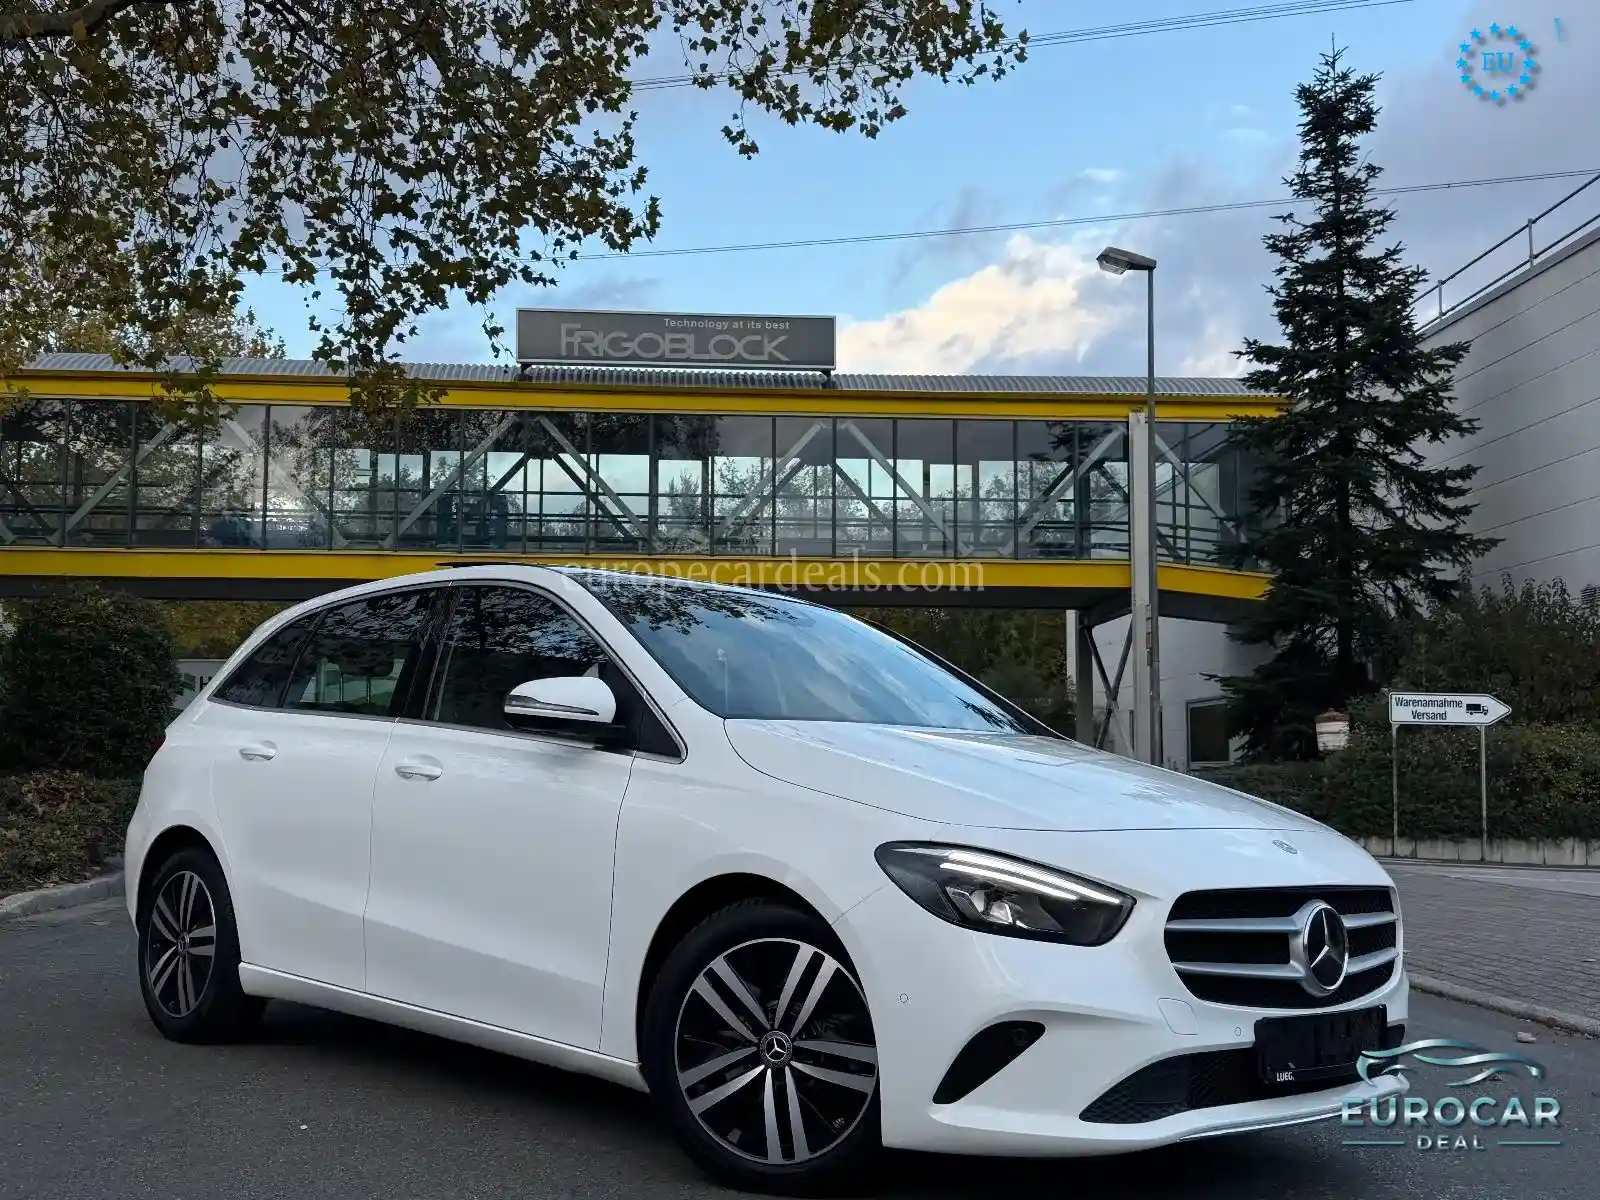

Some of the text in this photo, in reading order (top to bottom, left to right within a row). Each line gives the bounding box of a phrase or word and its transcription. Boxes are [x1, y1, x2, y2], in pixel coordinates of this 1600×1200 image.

[664, 318, 790, 329] Technology at its best
[560, 323, 790, 361] FRIGOBLOCK
[1394, 696, 1462, 708] Warenannahme
[1411, 709, 1447, 721] Versand
